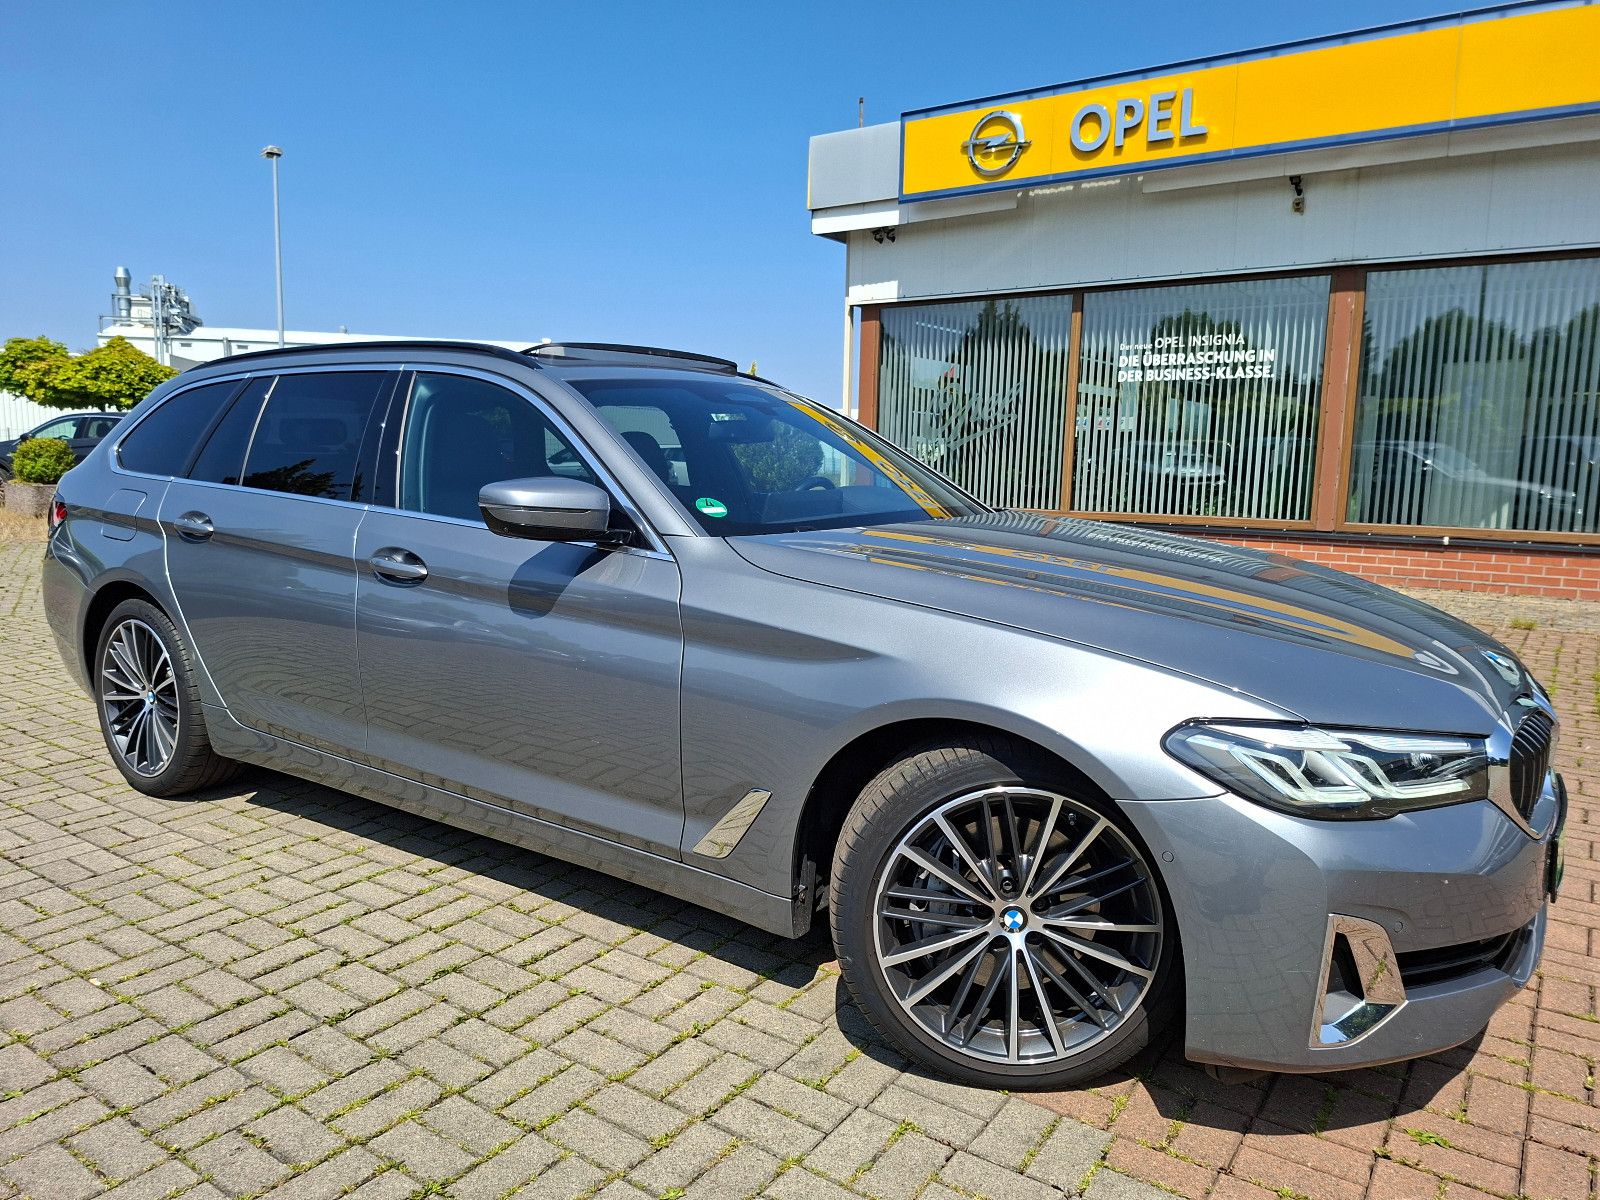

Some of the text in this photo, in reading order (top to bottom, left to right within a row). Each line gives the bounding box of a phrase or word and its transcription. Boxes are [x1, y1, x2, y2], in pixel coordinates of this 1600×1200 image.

[1070, 87, 1209, 153] OPEL
[1154, 336, 1185, 349] OPEL
[1188, 333, 1245, 347] INSIGNIA
[1119, 348, 1275, 368] DIE ÜBERRASCHUNG IN
[1117, 365, 1275, 383] DER BUSINESS-KLASSE.
[705, 498, 715, 508] 4
